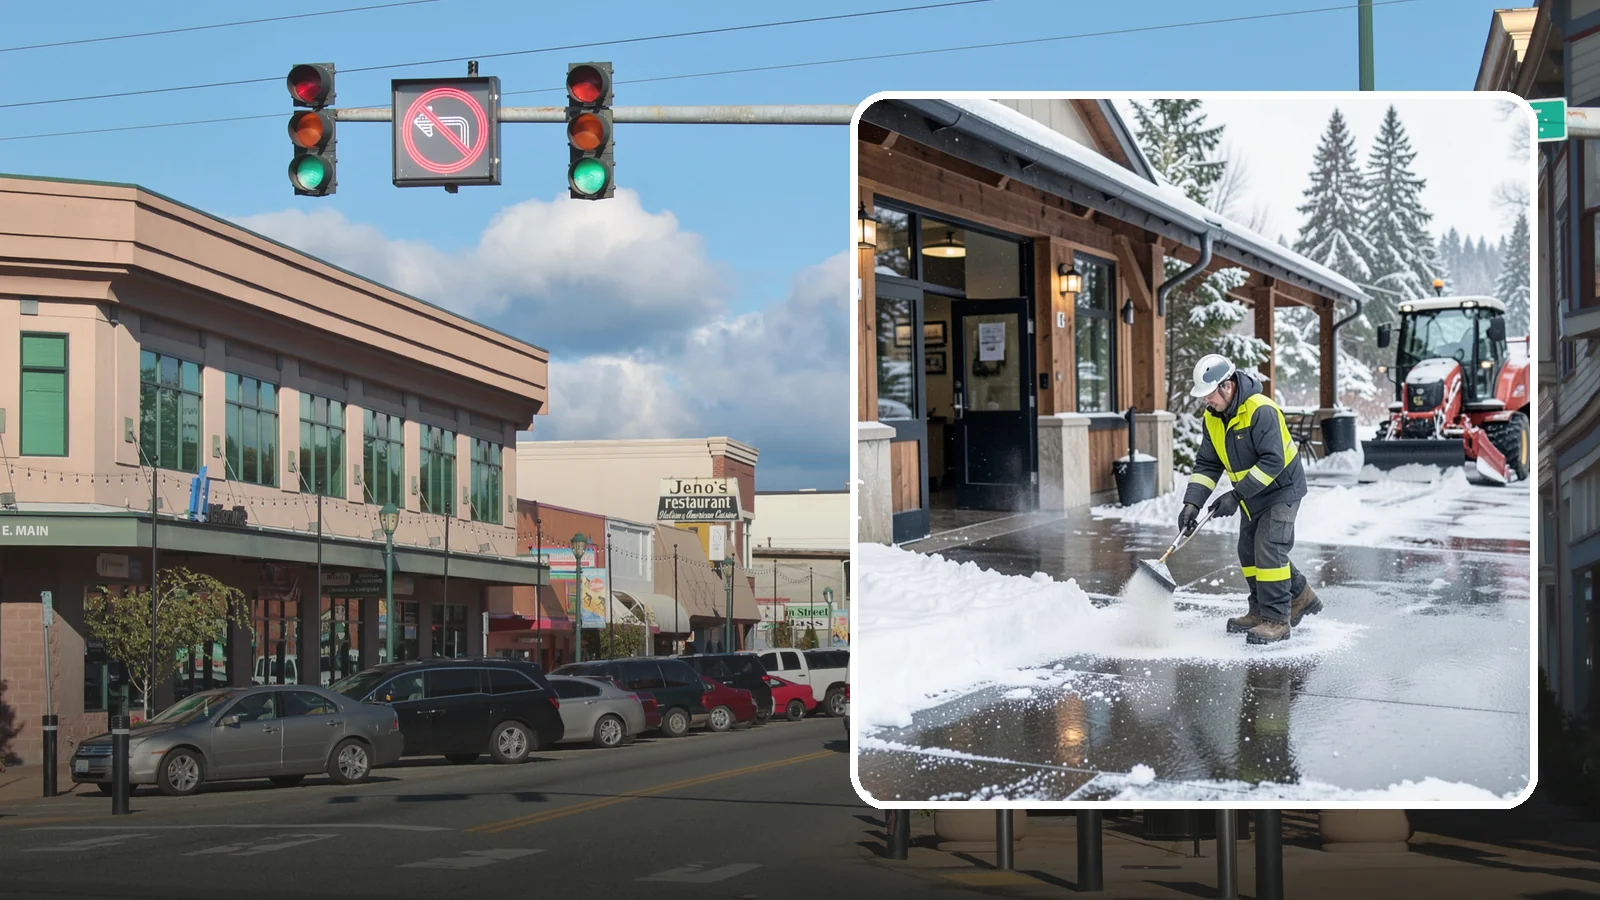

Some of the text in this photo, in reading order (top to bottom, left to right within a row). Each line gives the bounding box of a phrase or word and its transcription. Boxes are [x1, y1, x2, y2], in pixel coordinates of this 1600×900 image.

[669, 480, 728, 495] Jeno's
[665, 496, 731, 509] restaurant
[658, 510, 682, 519] Italian
[686, 509, 715, 519] American
[715, 509, 738, 519] Cuisine
[2, 525, 49, 536] E. MAIN
[797, 607, 828, 616] Street
